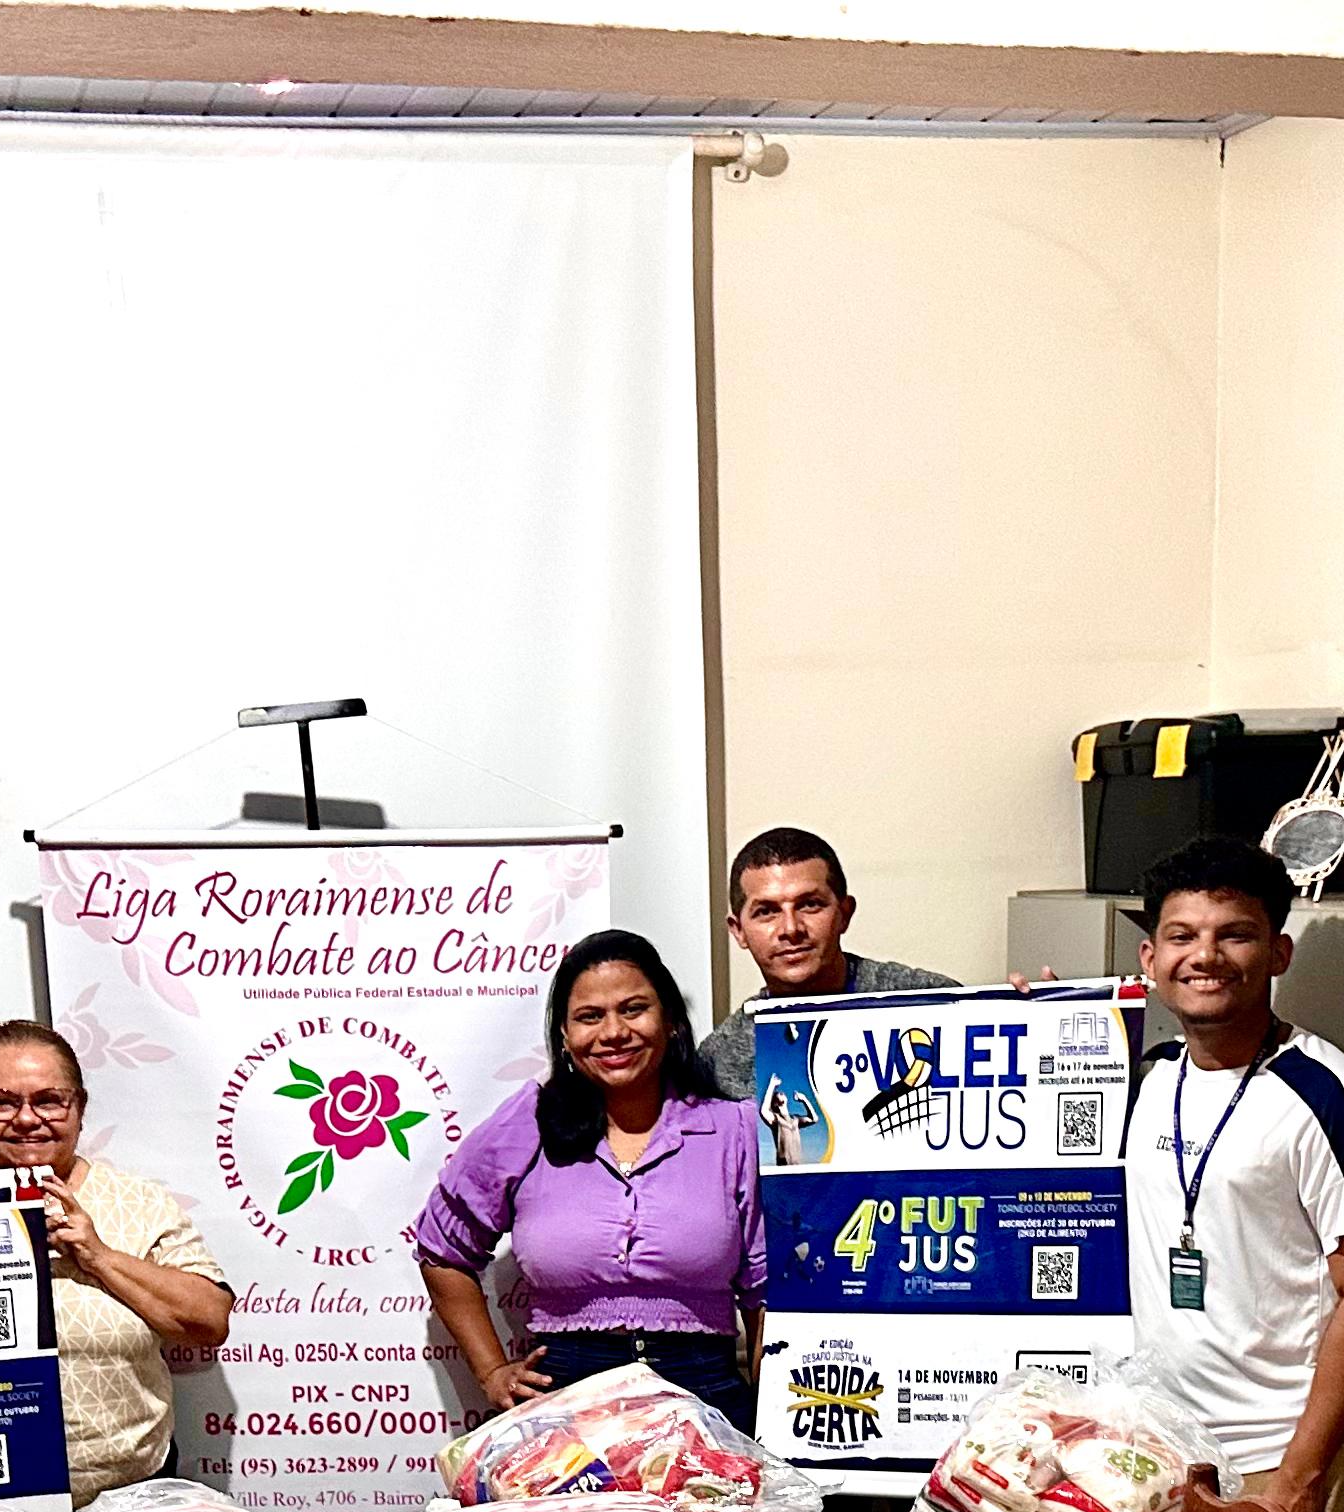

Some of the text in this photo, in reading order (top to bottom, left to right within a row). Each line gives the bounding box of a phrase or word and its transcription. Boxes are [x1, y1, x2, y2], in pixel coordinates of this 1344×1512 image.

[76, 859, 513, 945] Liga Roraimense de
[164, 921, 356, 977] Combate
[366, 946, 417, 975] ao
[243, 984, 539, 1000] Utilidade Pública Federal Estadual e Municipal
[1093, 1060, 1125, 1071] novembro
[925, 1089, 1027, 1151] JUS
[216, 1016, 463, 1249] LIGA RORAIMENSE DE COMBATE AO
[900, 1195, 986, 1234] FUT
[998, 1203, 1117, 1213] TORNEIO DE FUTEBOL SOCIETY
[1079, 1219, 1116, 1228] OUTUBRO
[0, 1259, 31, 1269] novembro
[312, 1245, 377, 1267] LRCC
[898, 1235, 978, 1273] JUS
[310, 1281, 369, 1316] luta,
[171, 1342, 416, 1368] do Brasil Ag. 0250-X conta
[829, 1338, 854, 1351] EDIÇÃO
[802, 1350, 873, 1366] DESAFIO JUSTIÇA NA
[789, 1364, 881, 1402] MEDIDA
[898, 1369, 998, 1385] 14 DE NOVEMBRO
[7, 1391, 40, 1402] SOCIETY
[291, 1385, 329, 1404] PIX
[351, 1384, 411, 1403] CNPJ
[791, 1401, 884, 1444] CERTA
[199, 1457, 233, 1475] Tel:
[240, 1457, 278, 1478] (95)
[284, 1456, 379, 1475] 3623-2899
[272, 1490, 312, 1510] Roy,
[316, 1489, 356, 1506] 4706
[373, 1490, 425, 1506] Bairro
